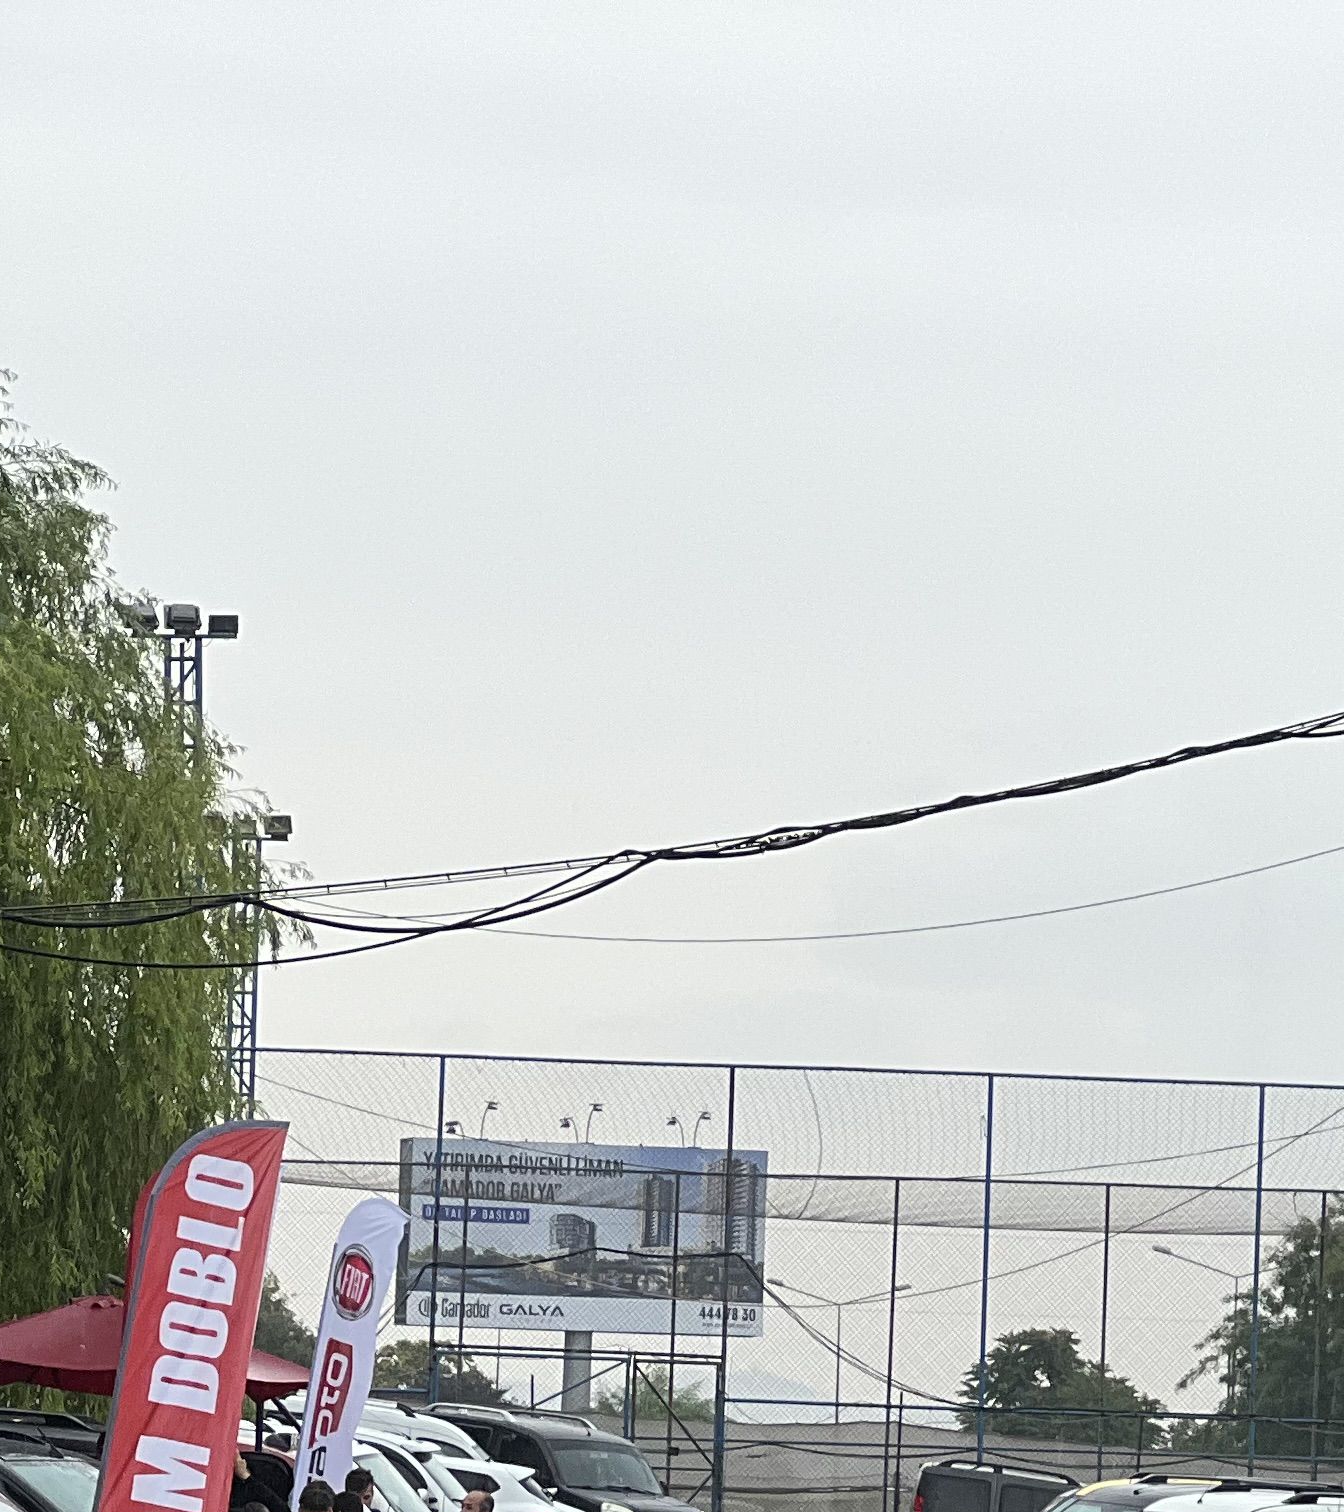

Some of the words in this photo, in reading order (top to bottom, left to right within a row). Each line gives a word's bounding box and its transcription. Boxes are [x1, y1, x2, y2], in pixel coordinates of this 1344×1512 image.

[148, 1152, 256, 1416] DOBLO
[341, 1263, 371, 1304] FIAT
[499, 1303, 564, 1317] GALYA
[698, 1306, 721, 1320] 444
[741, 1308, 756, 1321] 30
